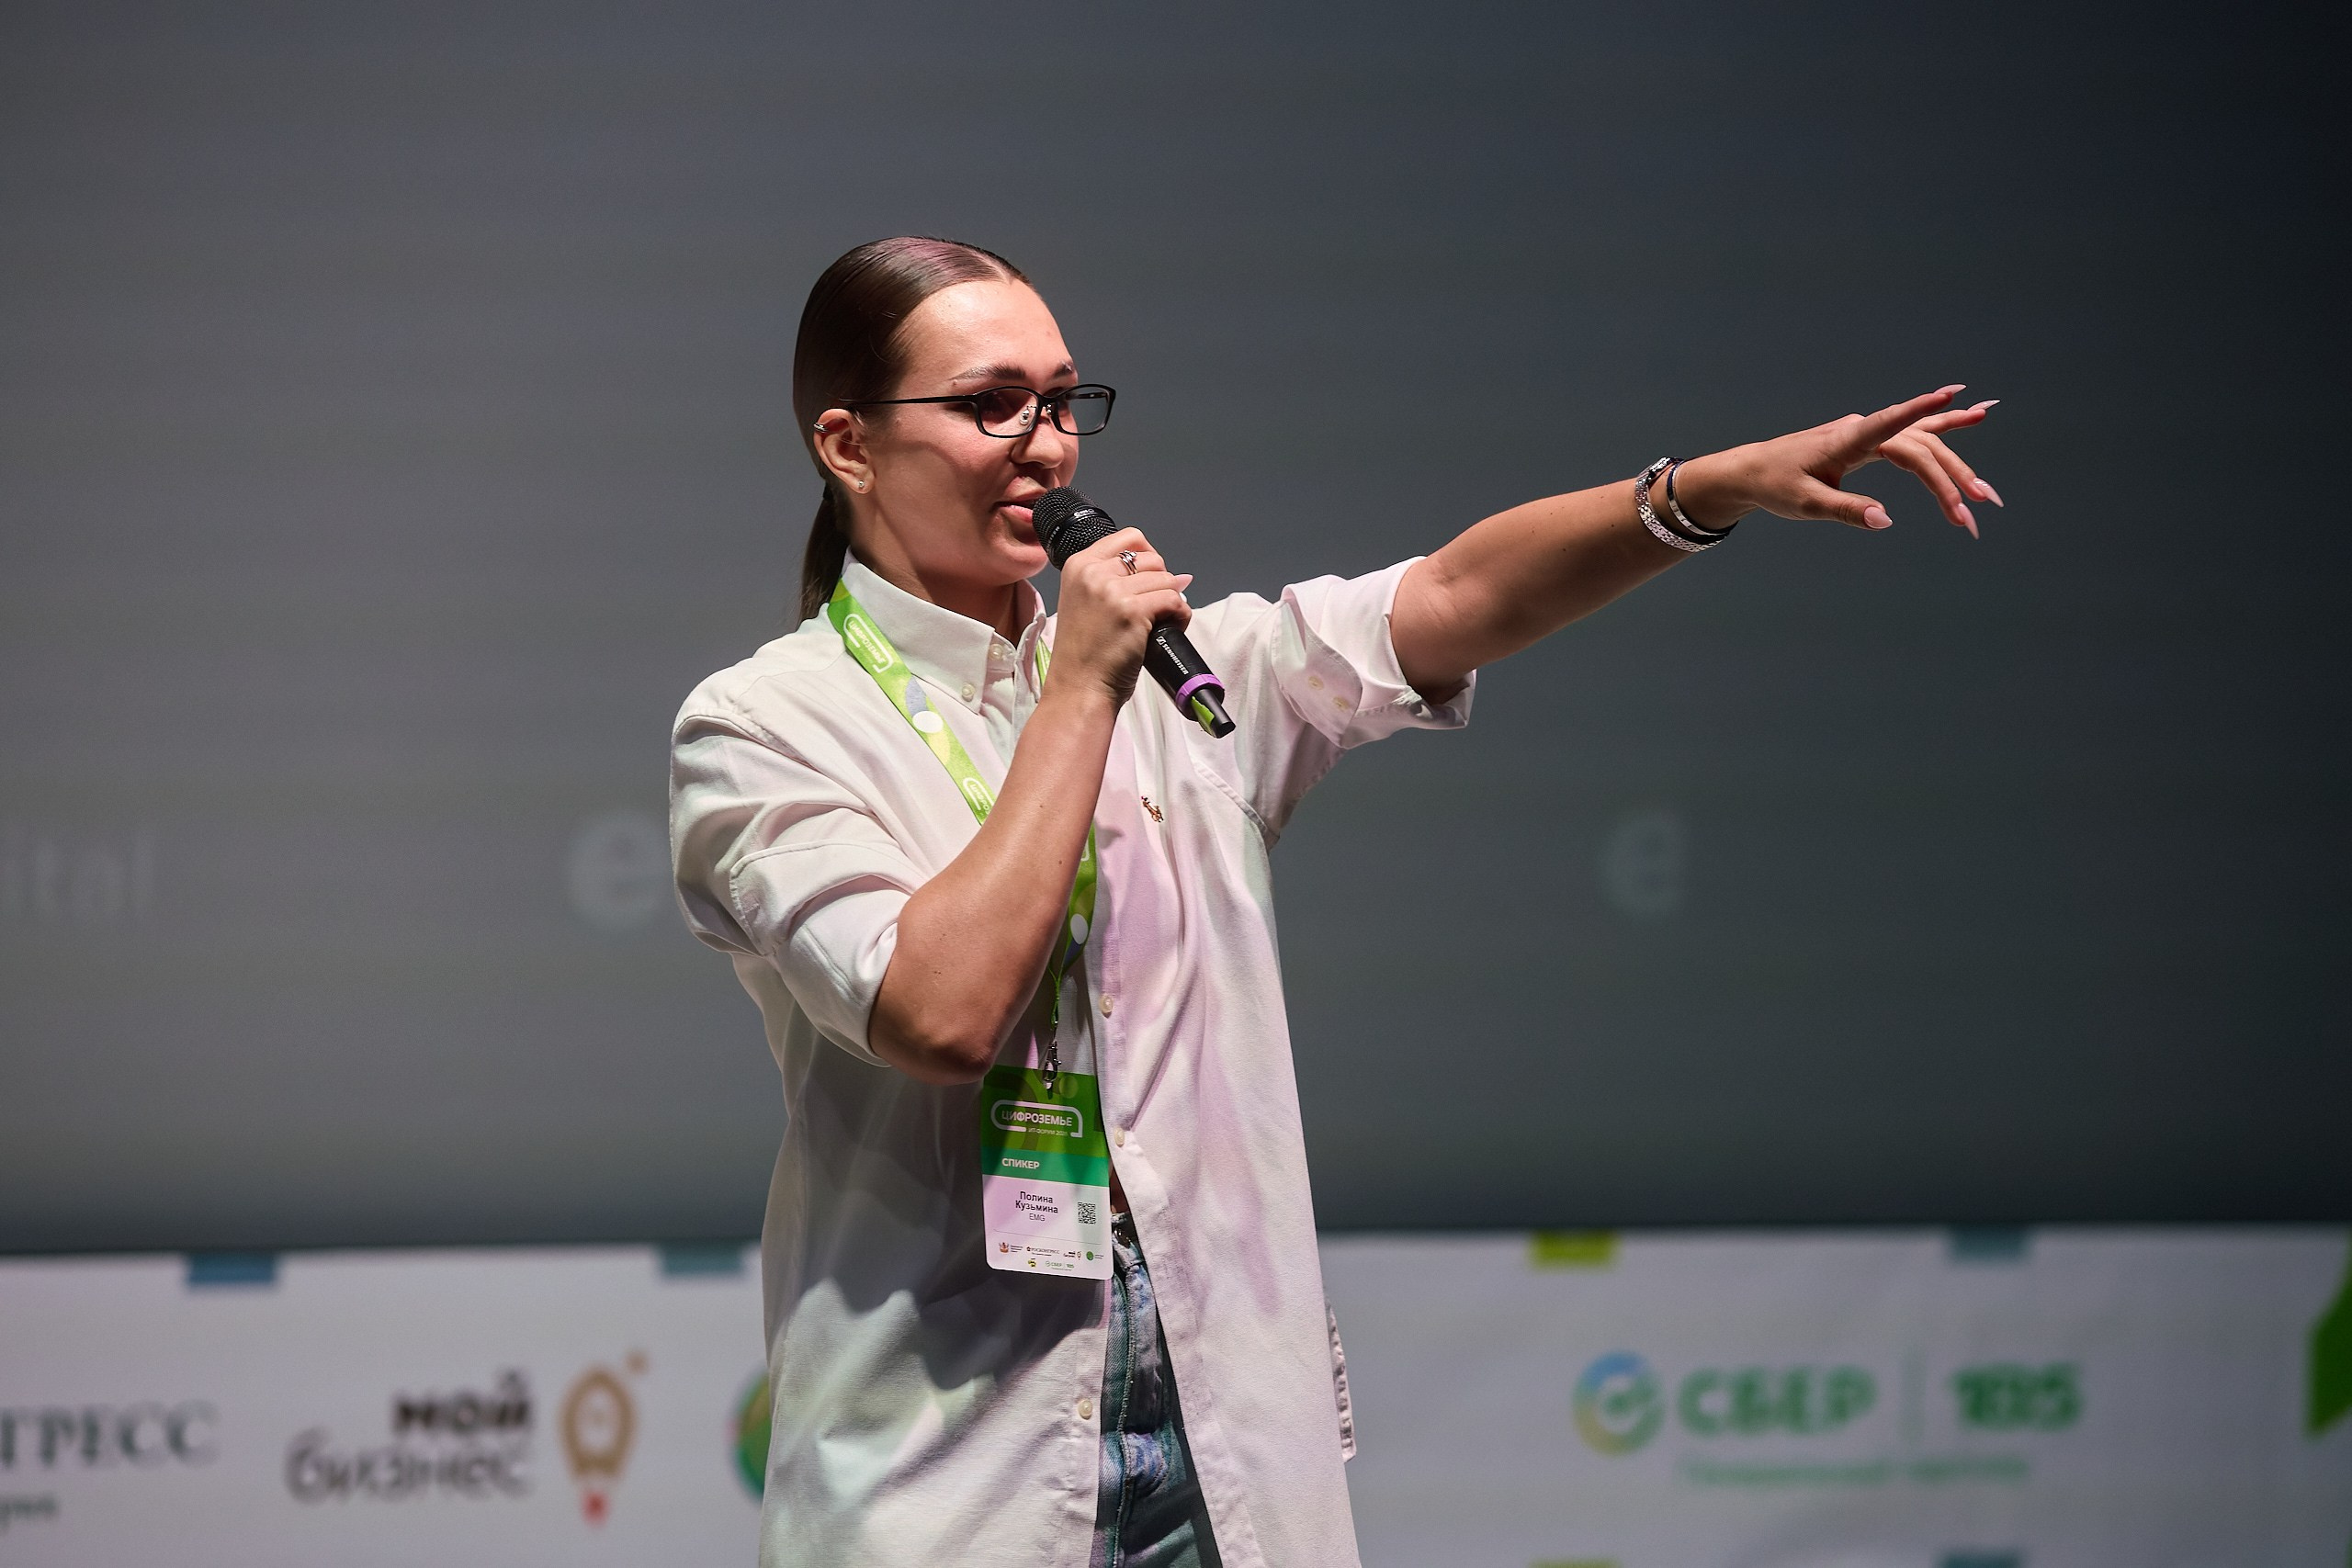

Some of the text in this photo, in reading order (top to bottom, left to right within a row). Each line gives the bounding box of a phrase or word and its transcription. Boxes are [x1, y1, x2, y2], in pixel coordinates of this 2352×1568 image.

[1161, 643, 1190, 675] SENNHEISER
[969, 783, 992, 816] ЦИФРО
[1001, 1110, 1073, 1127] ЦИФРОЗЕМЬЕ
[1001, 1157, 1040, 1169] СПИКЕР
[1020, 1190, 1053, 1203] Полина
[1015, 1200, 1058, 1213] Кузьмина
[1029, 1213, 1046, 1222] EMG
[1677, 1366, 1877, 1435] СБЕР
